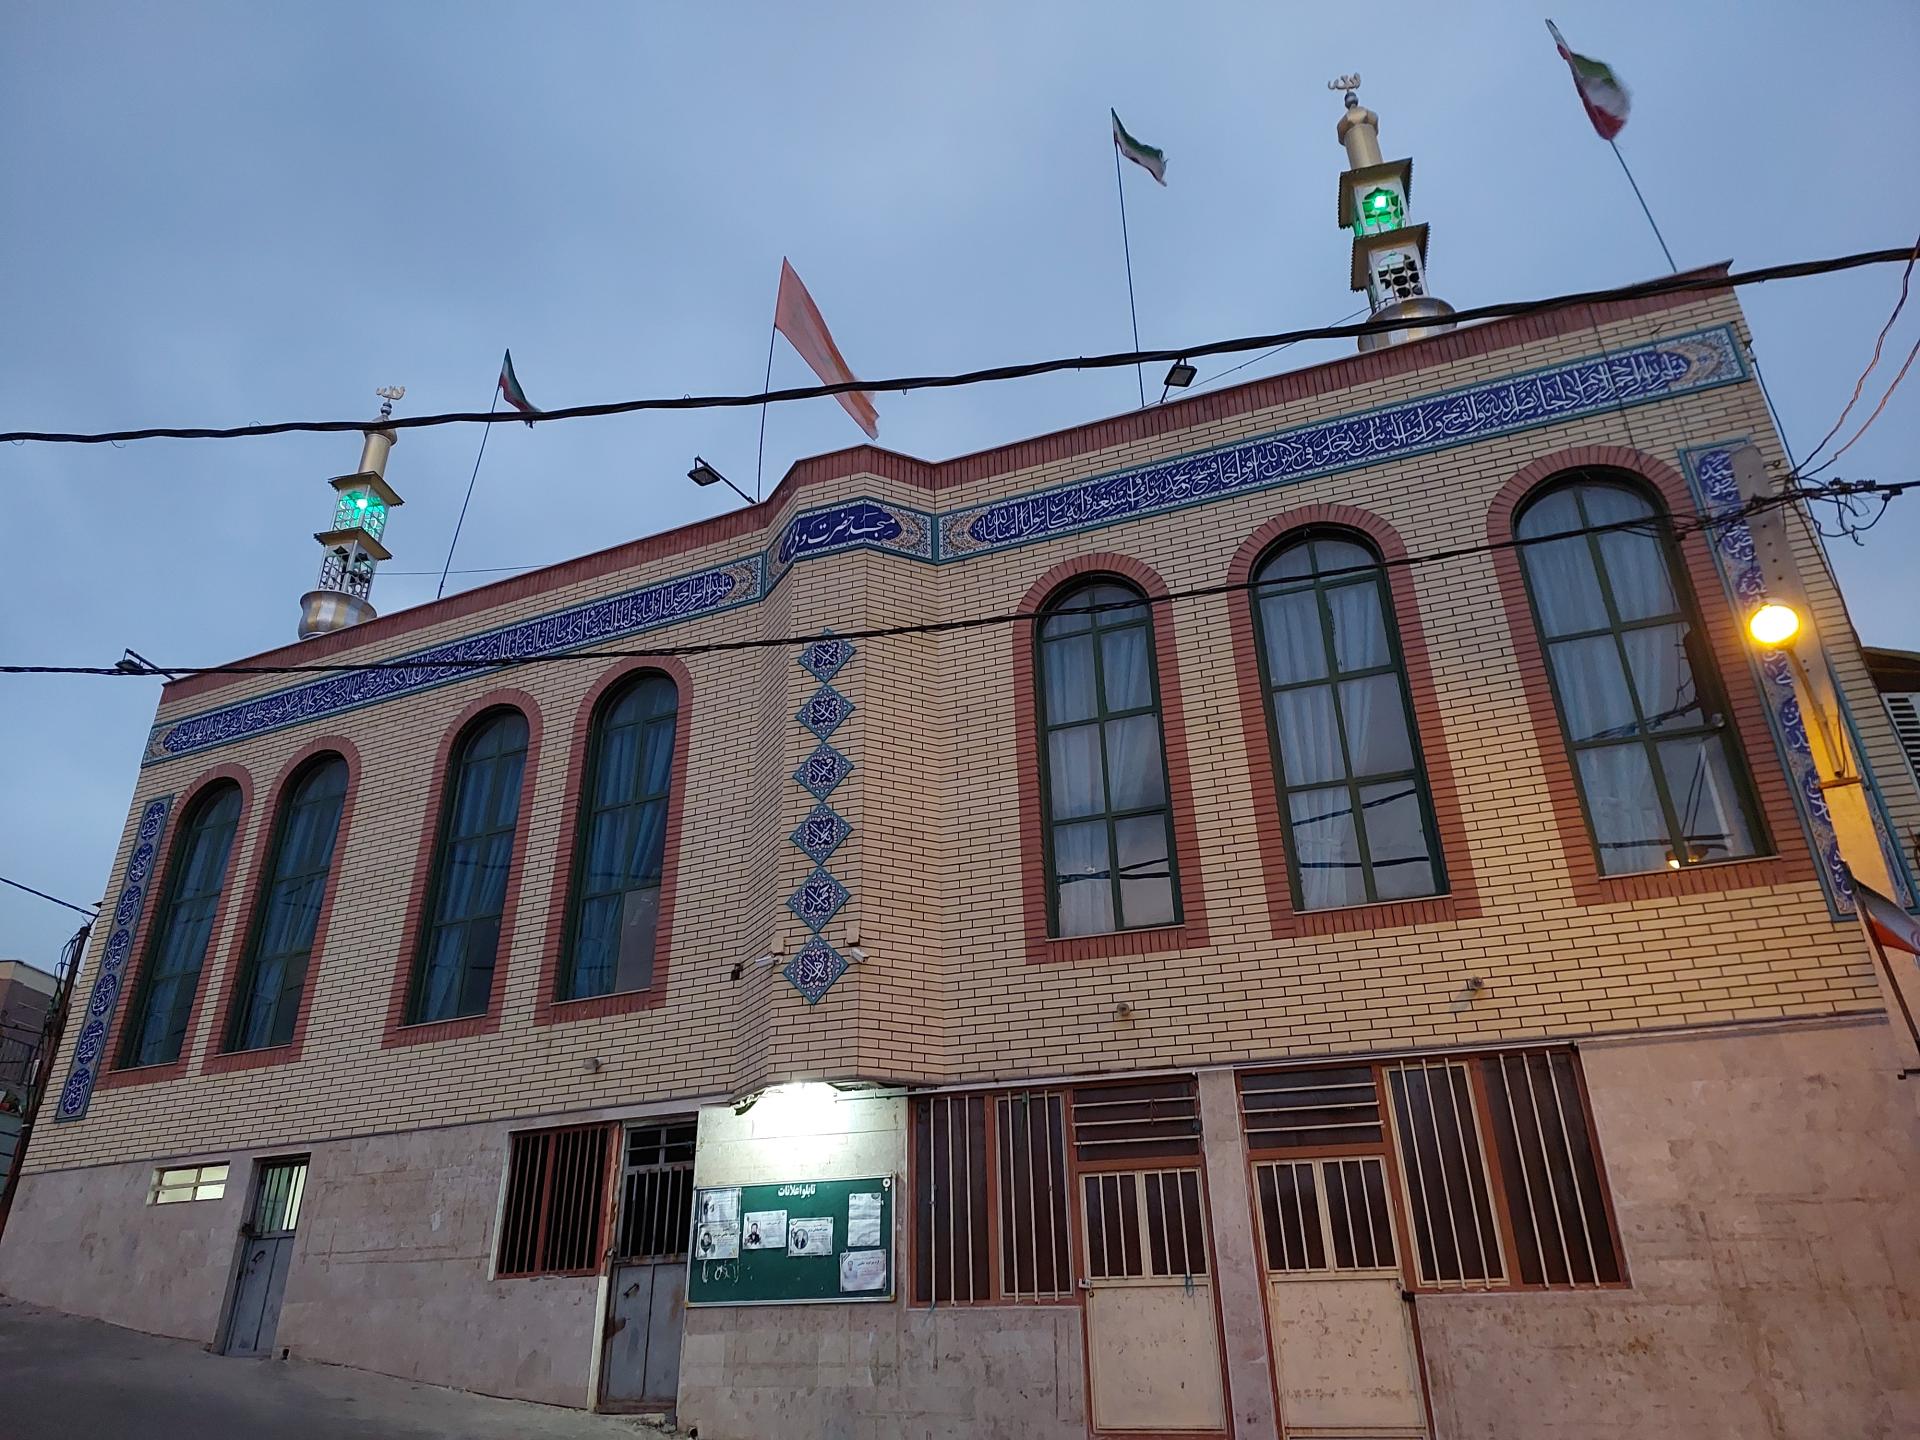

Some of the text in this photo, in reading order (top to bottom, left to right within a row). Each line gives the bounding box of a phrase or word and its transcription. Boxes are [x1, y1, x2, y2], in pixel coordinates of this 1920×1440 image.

[808, 512, 855, 545] حضرت
[844, 512, 896, 538] مسجد
[778, 1184, 816, 1198] تابلو اعلانات
